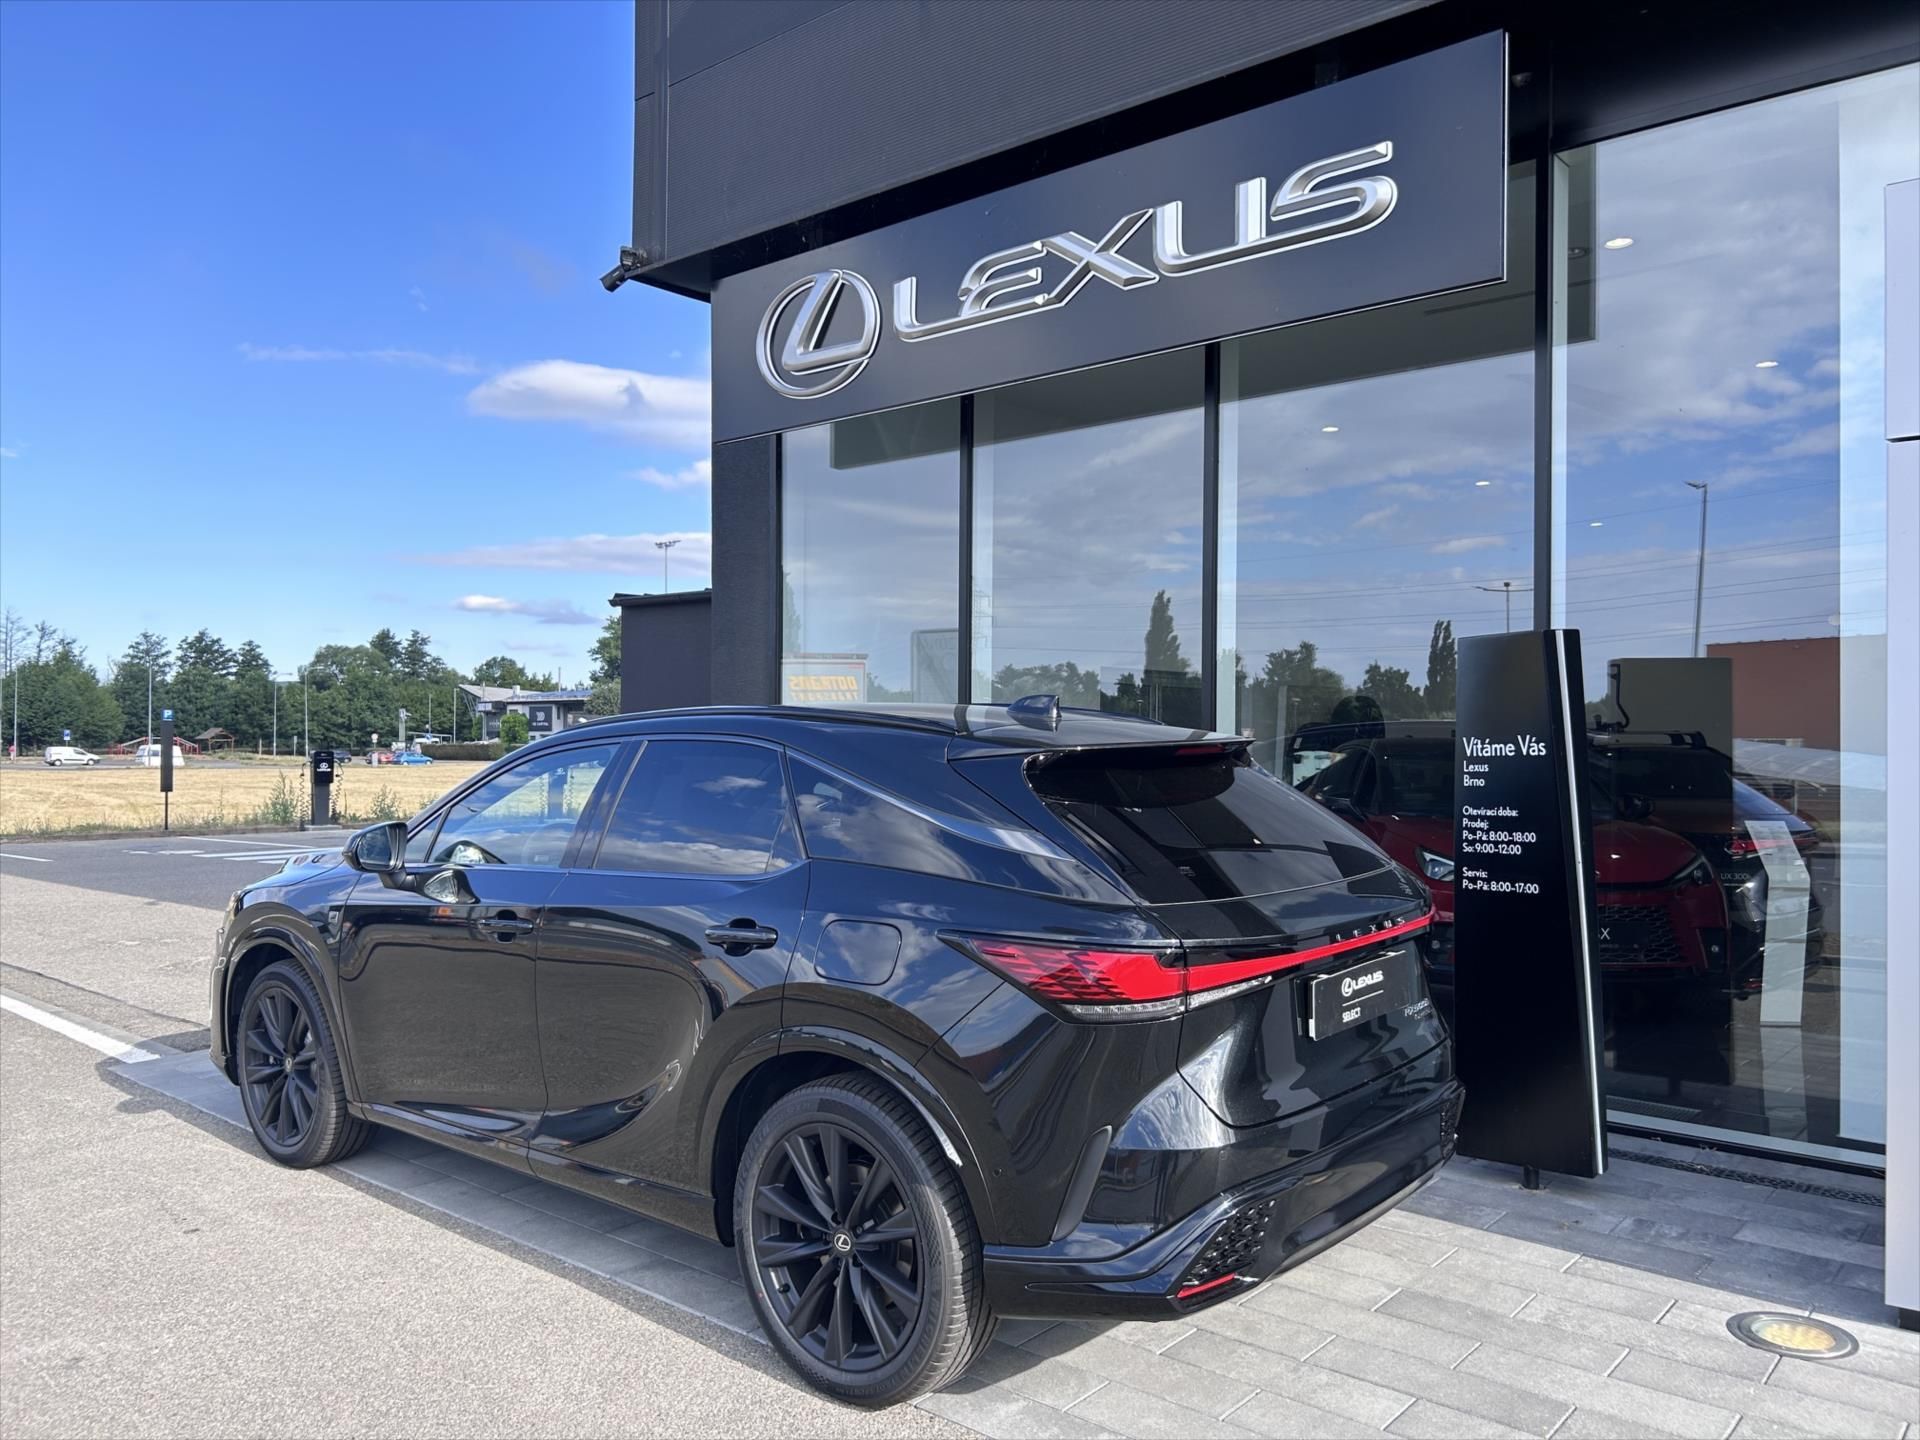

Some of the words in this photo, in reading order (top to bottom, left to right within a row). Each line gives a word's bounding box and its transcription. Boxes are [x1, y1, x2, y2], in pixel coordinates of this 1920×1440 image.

[893, 140, 1398, 342] LEXUS
[1462, 736, 1515, 757] Vítáme
[1517, 735, 1547, 756] Vás
[1463, 761, 1489, 772] Lexus
[1463, 775, 1485, 786] Brno
[1462, 805, 1497, 816] Otevírací
[1497, 806, 1519, 817] doba:
[1462, 818, 1489, 830] Prodej:
[1489, 831, 1537, 843] 8:00-18:00
[1462, 842, 1475, 853] So:
[1475, 843, 1522, 855] 9:00-12:00
[1462, 866, 1489, 878] Servis:
[1490, 881, 1539, 894] 8:00-17:00
[1335, 916, 1406, 942] LEXUS
[1599, 927, 1611, 940] X
[1353, 970, 1384, 990] LEXUS
[1342, 1006, 1361, 1023] SELECT
